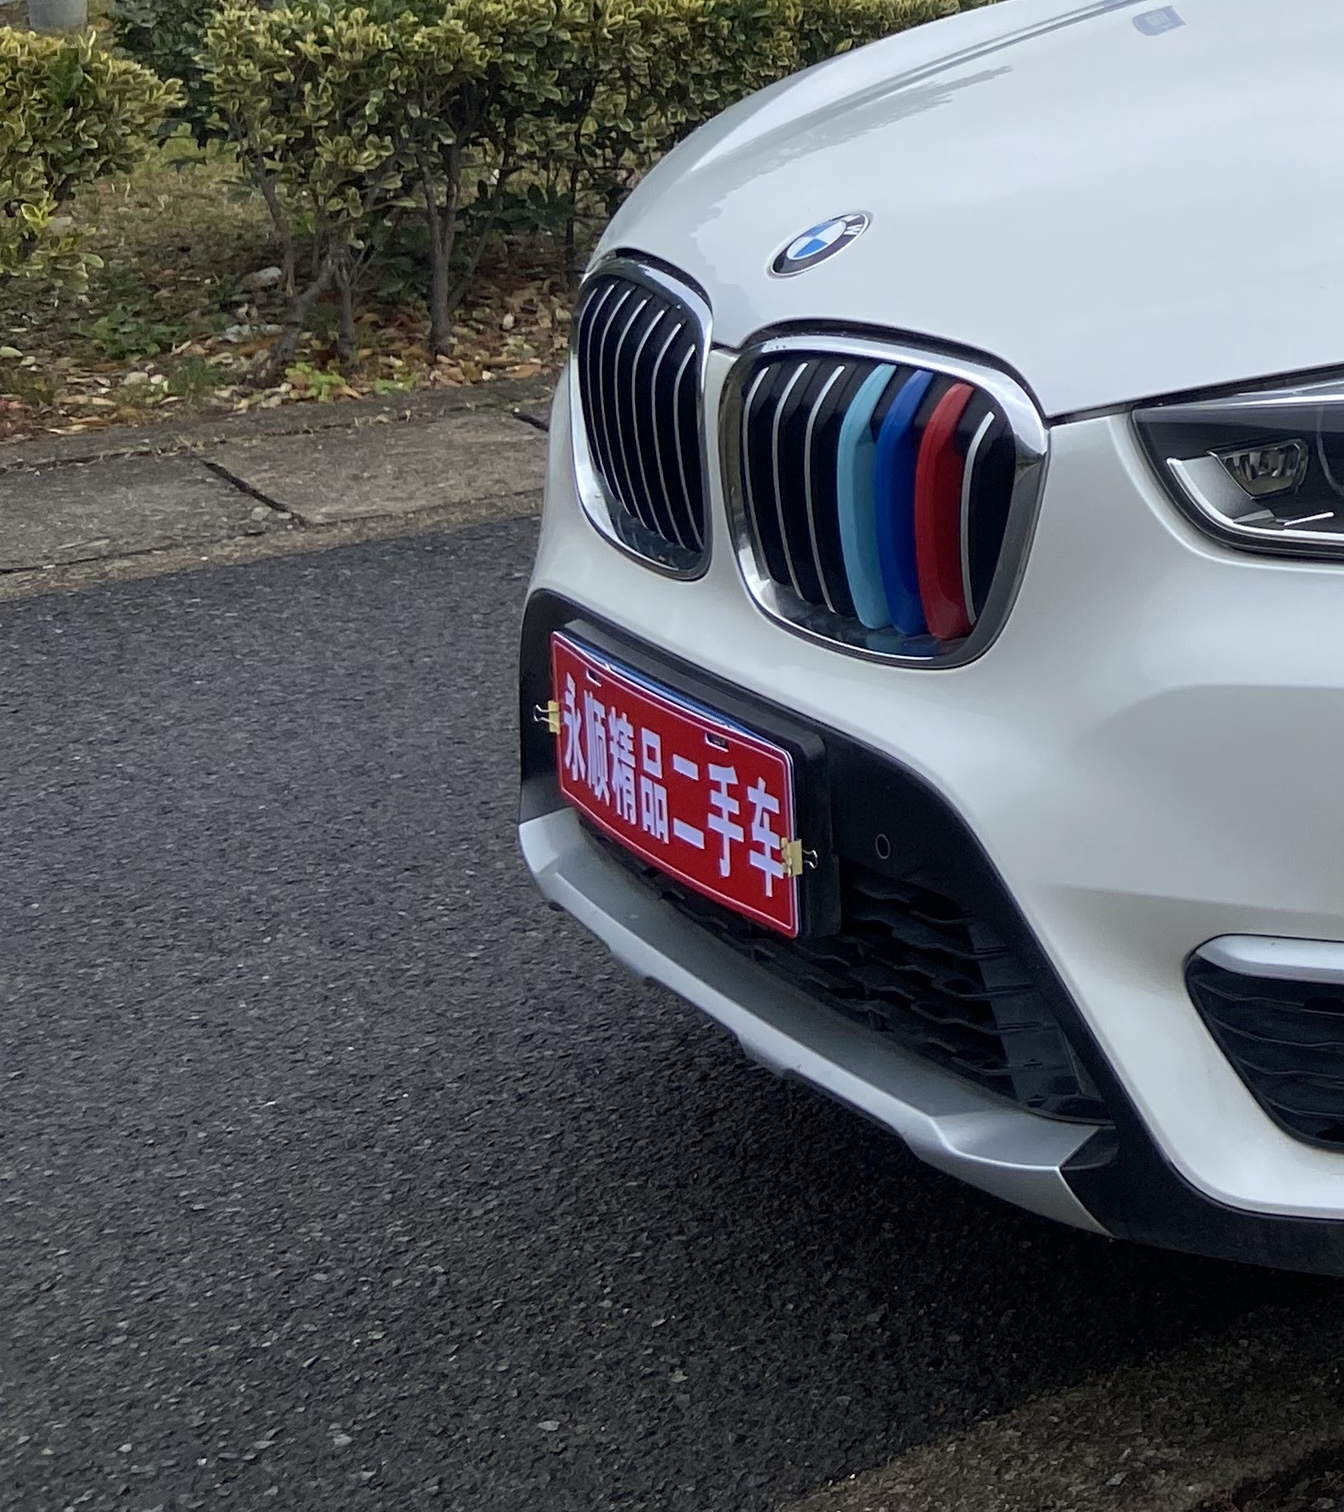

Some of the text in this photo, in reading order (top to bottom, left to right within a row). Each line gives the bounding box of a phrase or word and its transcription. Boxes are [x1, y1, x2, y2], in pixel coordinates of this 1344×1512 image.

[563, 672, 785, 898] 永顺精品二手车
